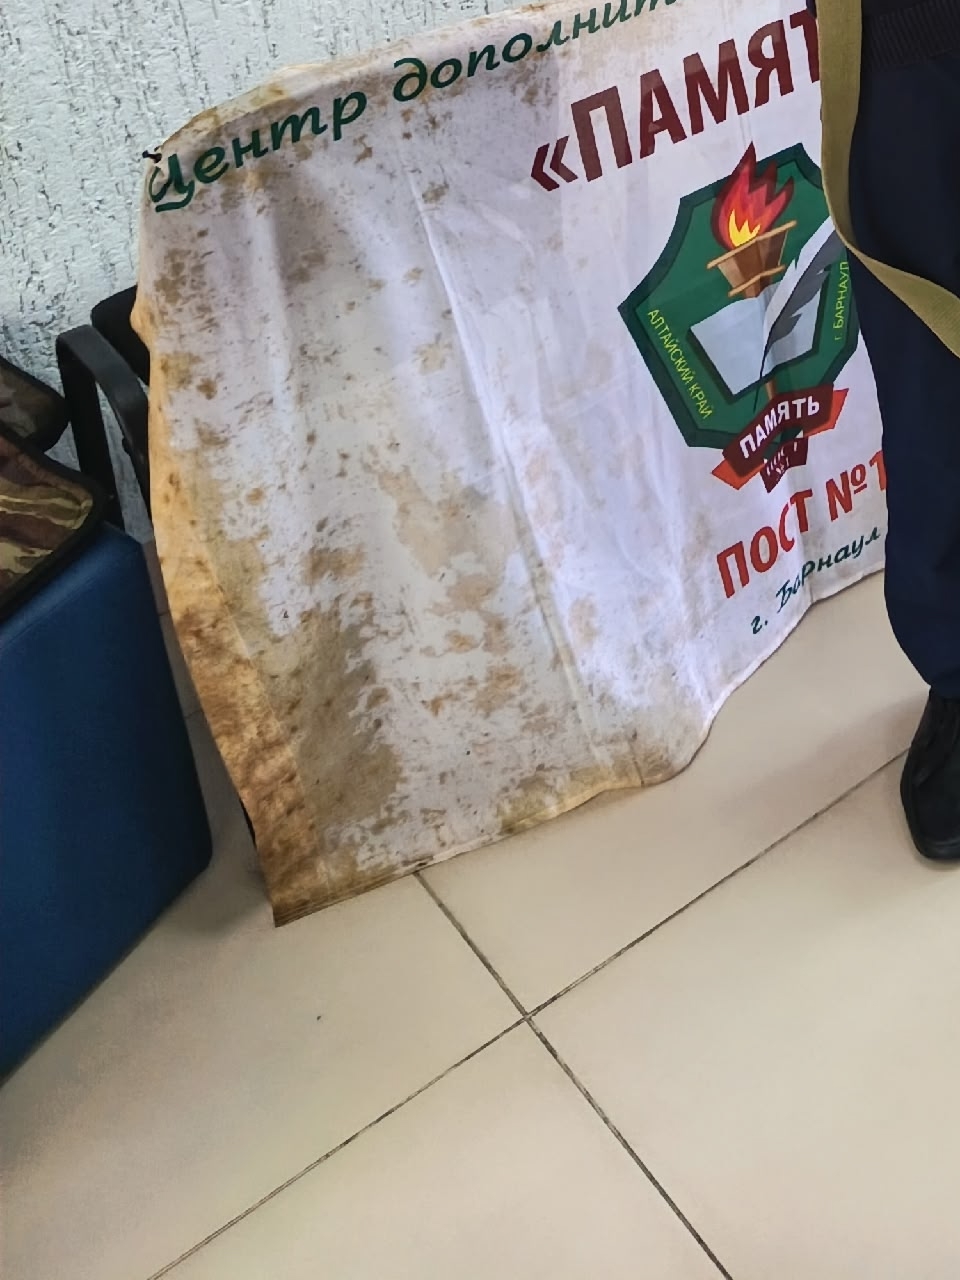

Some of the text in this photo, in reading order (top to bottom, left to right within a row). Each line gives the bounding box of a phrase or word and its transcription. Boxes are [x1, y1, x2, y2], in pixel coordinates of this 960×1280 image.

[148, 91, 367, 213] Центр
[832, 261, 849, 329] БАРНАУЛ
[648, 309, 713, 419] АЛТАЙСКИЙ КРАЙ
[739, 395, 820, 459] ПАМЯТЬ
[716, 488, 813, 599] ПОСТ
[751, 527, 880, 634] г. Барнаул
